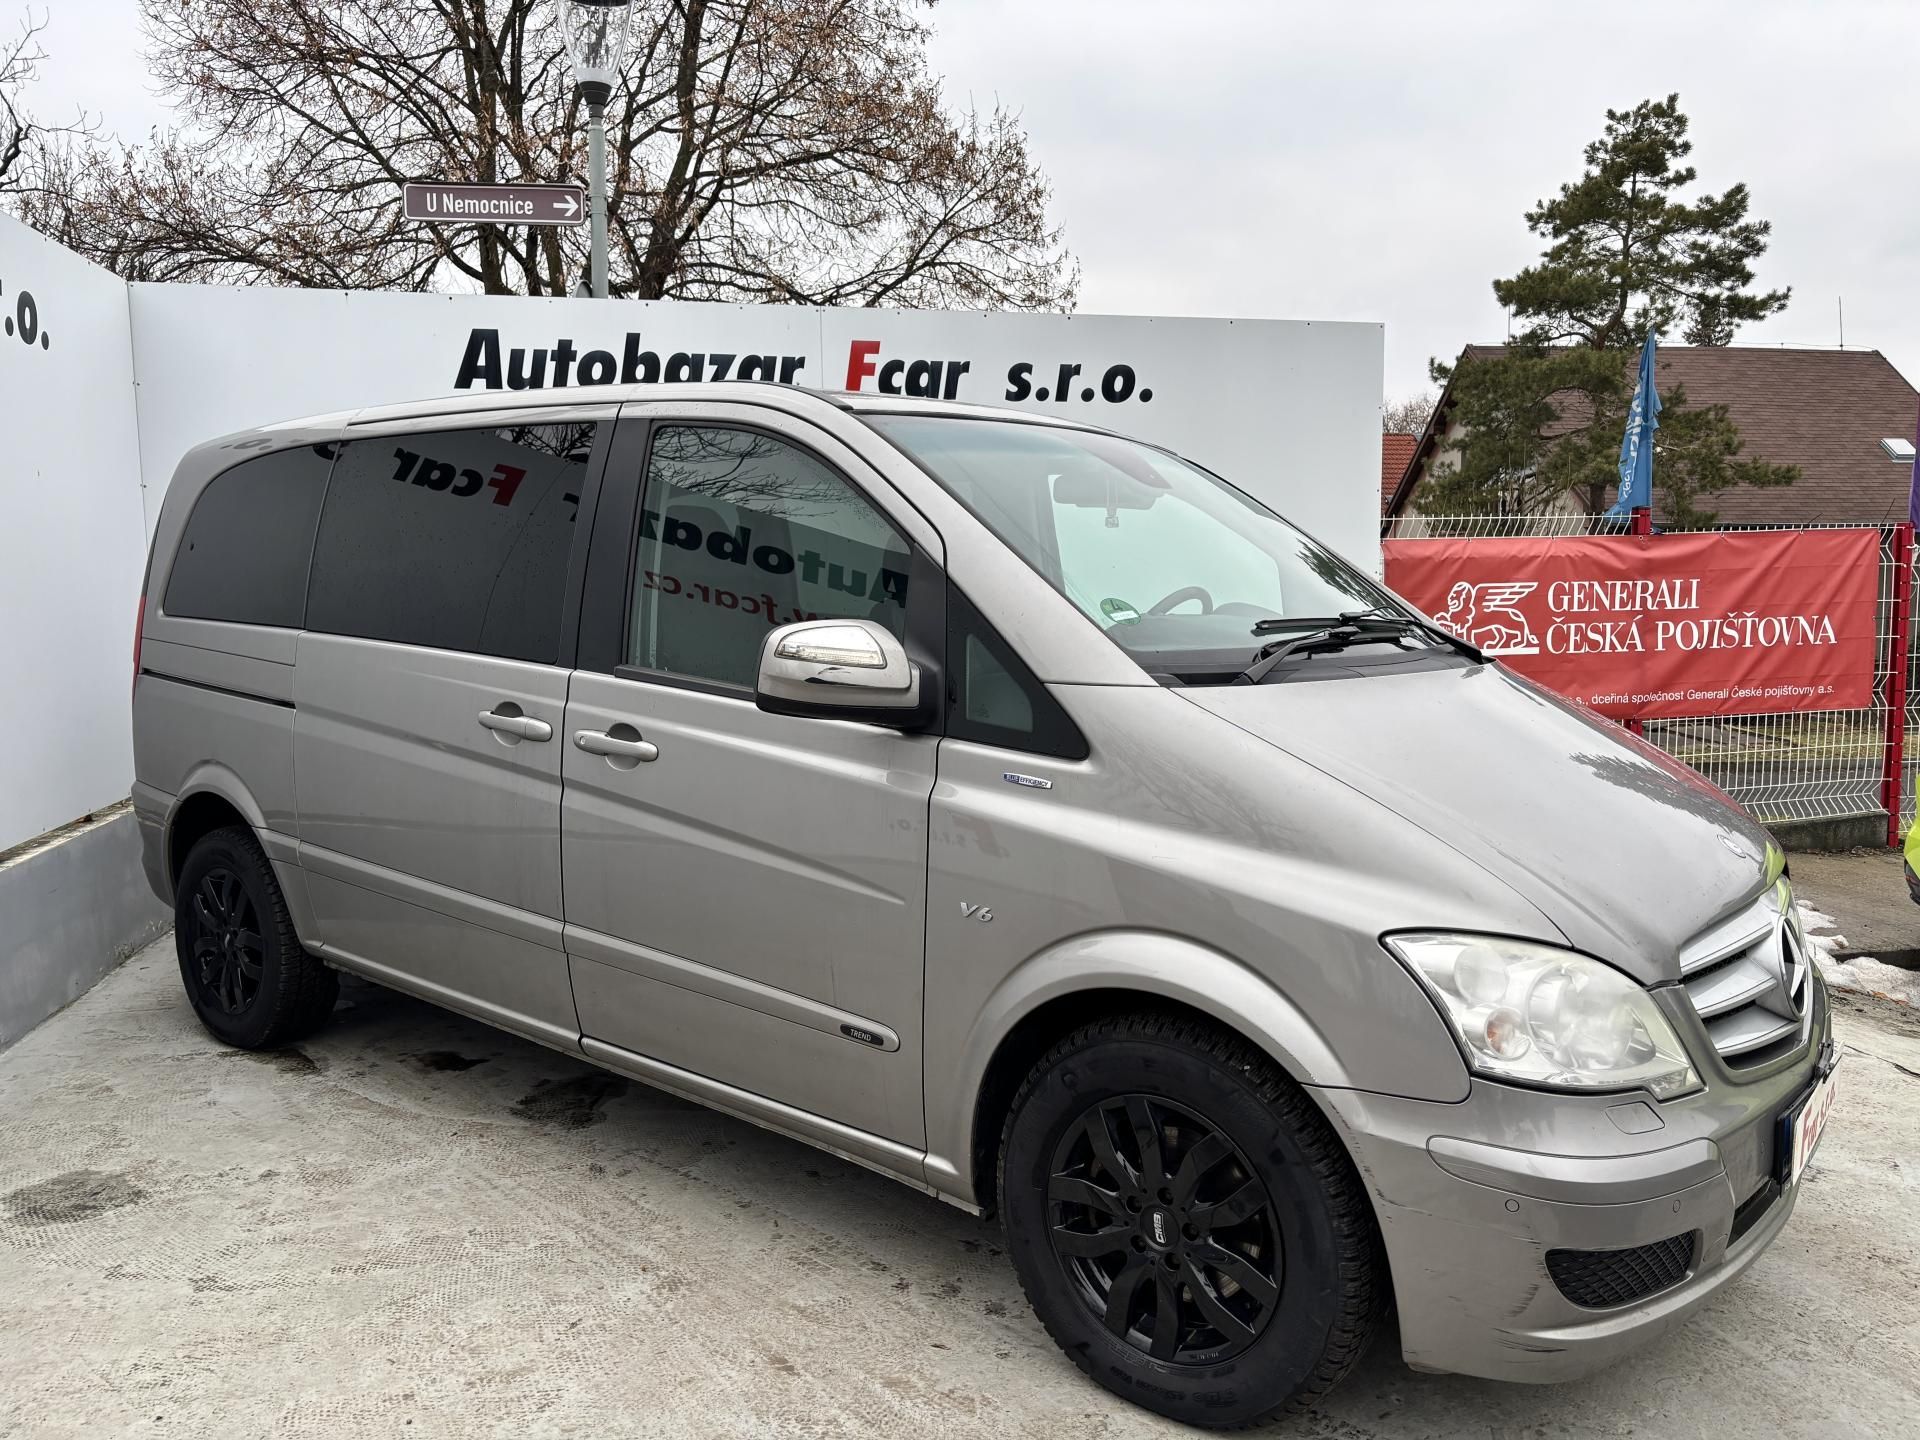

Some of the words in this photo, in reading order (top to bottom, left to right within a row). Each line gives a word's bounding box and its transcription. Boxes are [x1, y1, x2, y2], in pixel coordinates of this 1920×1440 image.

[426, 192, 437, 212] U
[442, 193, 534, 215] Nemocnice
[0, 278, 49, 350] .o.
[453, 328, 805, 390] Autobazar
[845, 340, 970, 400] Fcar
[1004, 362, 1153, 403] s.r.o.
[1547, 578, 1700, 612] GENERALI
[1546, 614, 1645, 654] ČESKÁ
[1655, 610, 1838, 651] POJIŠŤOVNA
[1591, 692, 1629, 705] dceřiná
[1631, 690, 1684, 705] společnost
[1686, 688, 1729, 700] Generali
[1731, 685, 1762, 698] České
[1764, 684, 1815, 699] pojišťovny
[1818, 684, 1835, 694] a.s.
[960, 901, 993, 922] V6
[850, 1028, 872, 1042] TREND
